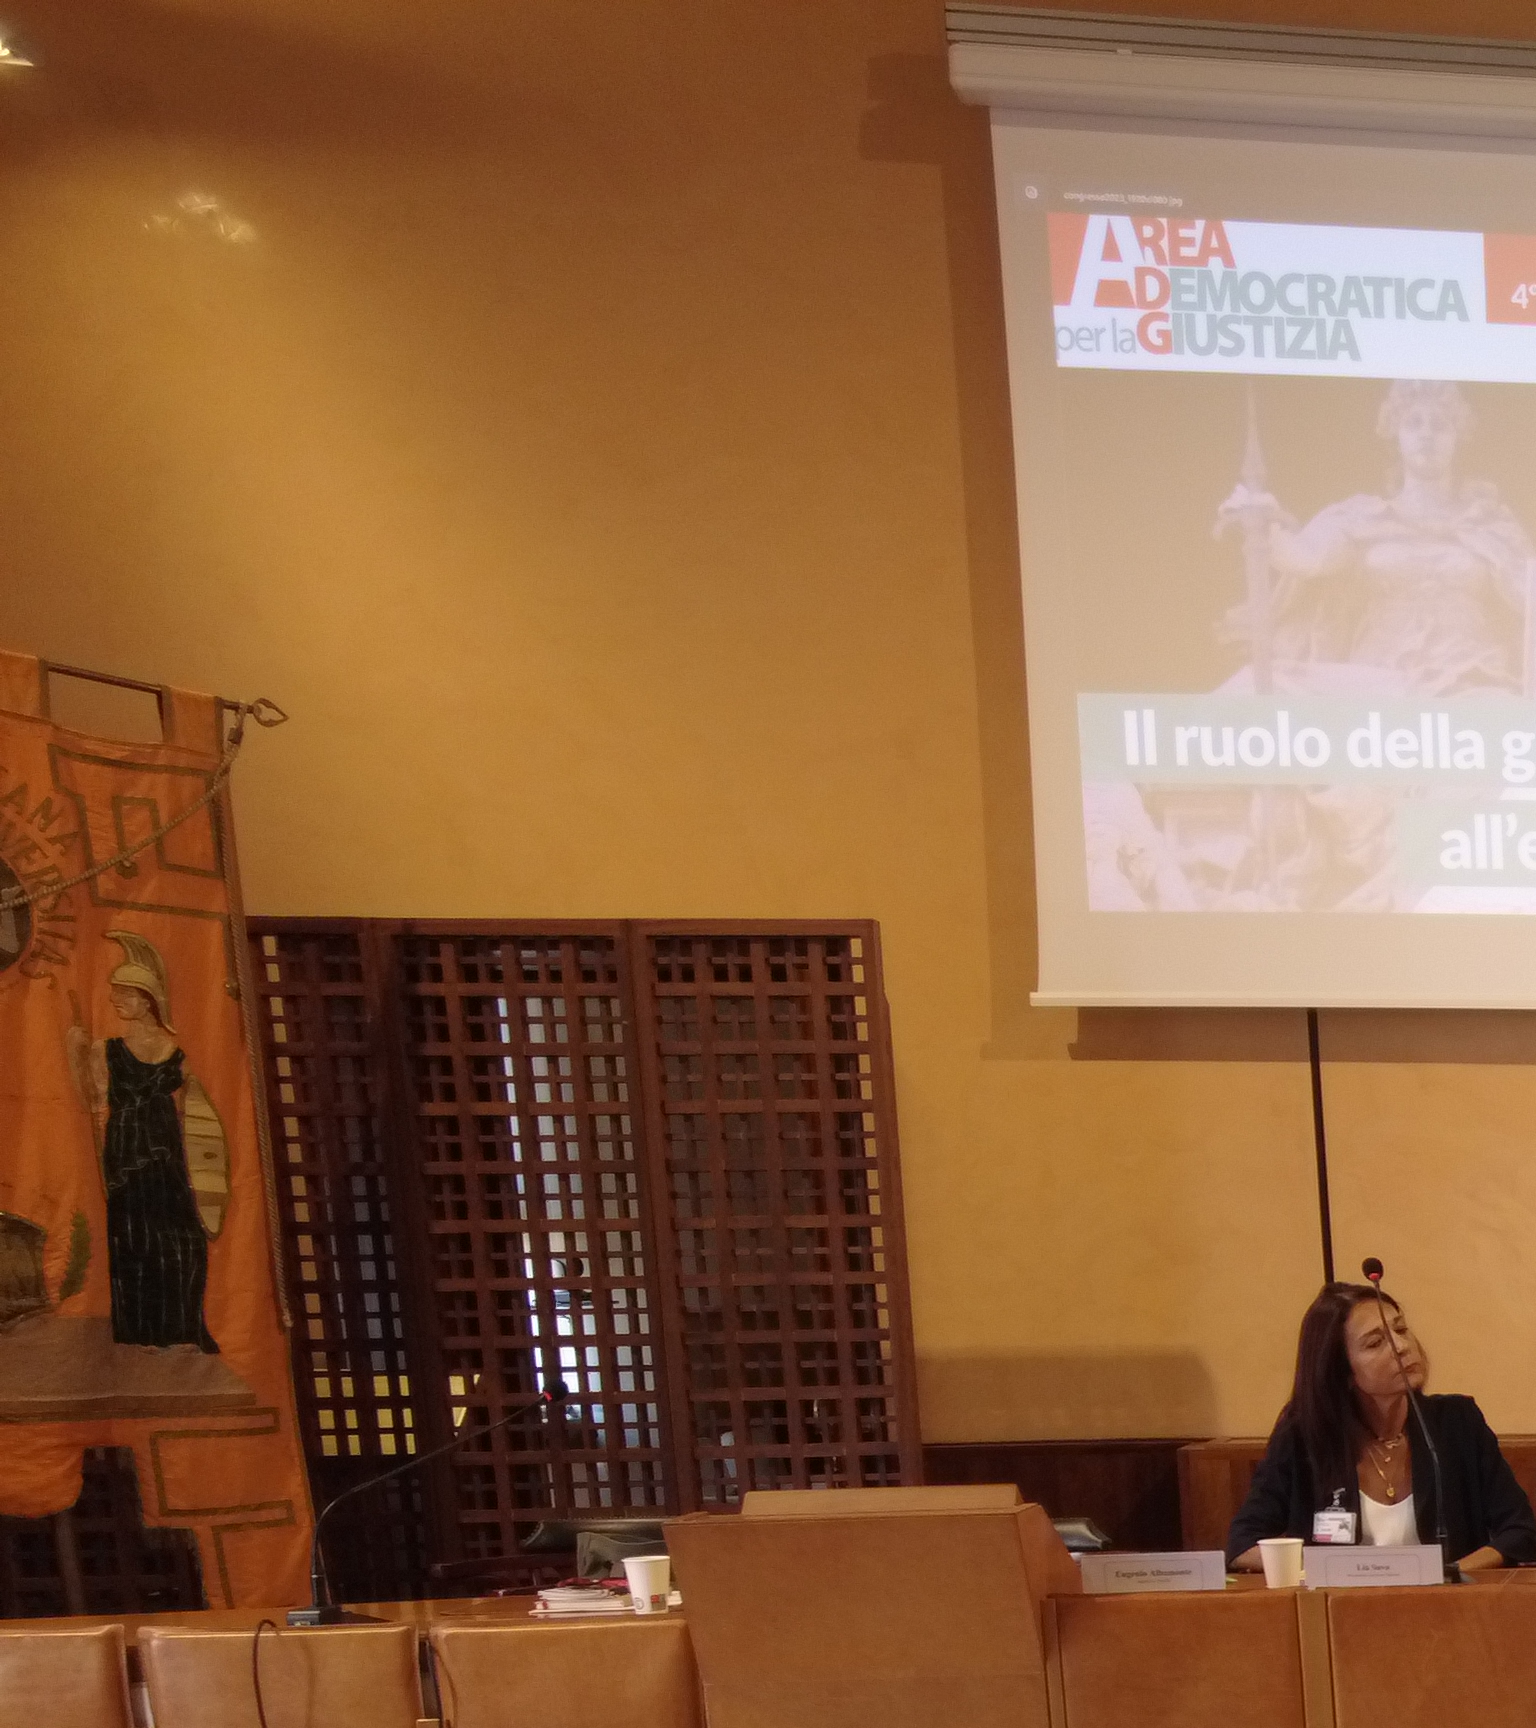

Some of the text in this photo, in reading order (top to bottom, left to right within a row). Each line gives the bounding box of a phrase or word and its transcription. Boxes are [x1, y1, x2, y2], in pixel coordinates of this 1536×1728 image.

[1070, 214, 1236, 307] AREA
[1134, 266, 1470, 322] DEMOCRATICA
[1136, 311, 1362, 361] GIUSTIZIA
[1124, 710, 1157, 766] Il
[1175, 712, 1331, 769] ruolo
[1346, 711, 1486, 770] della
